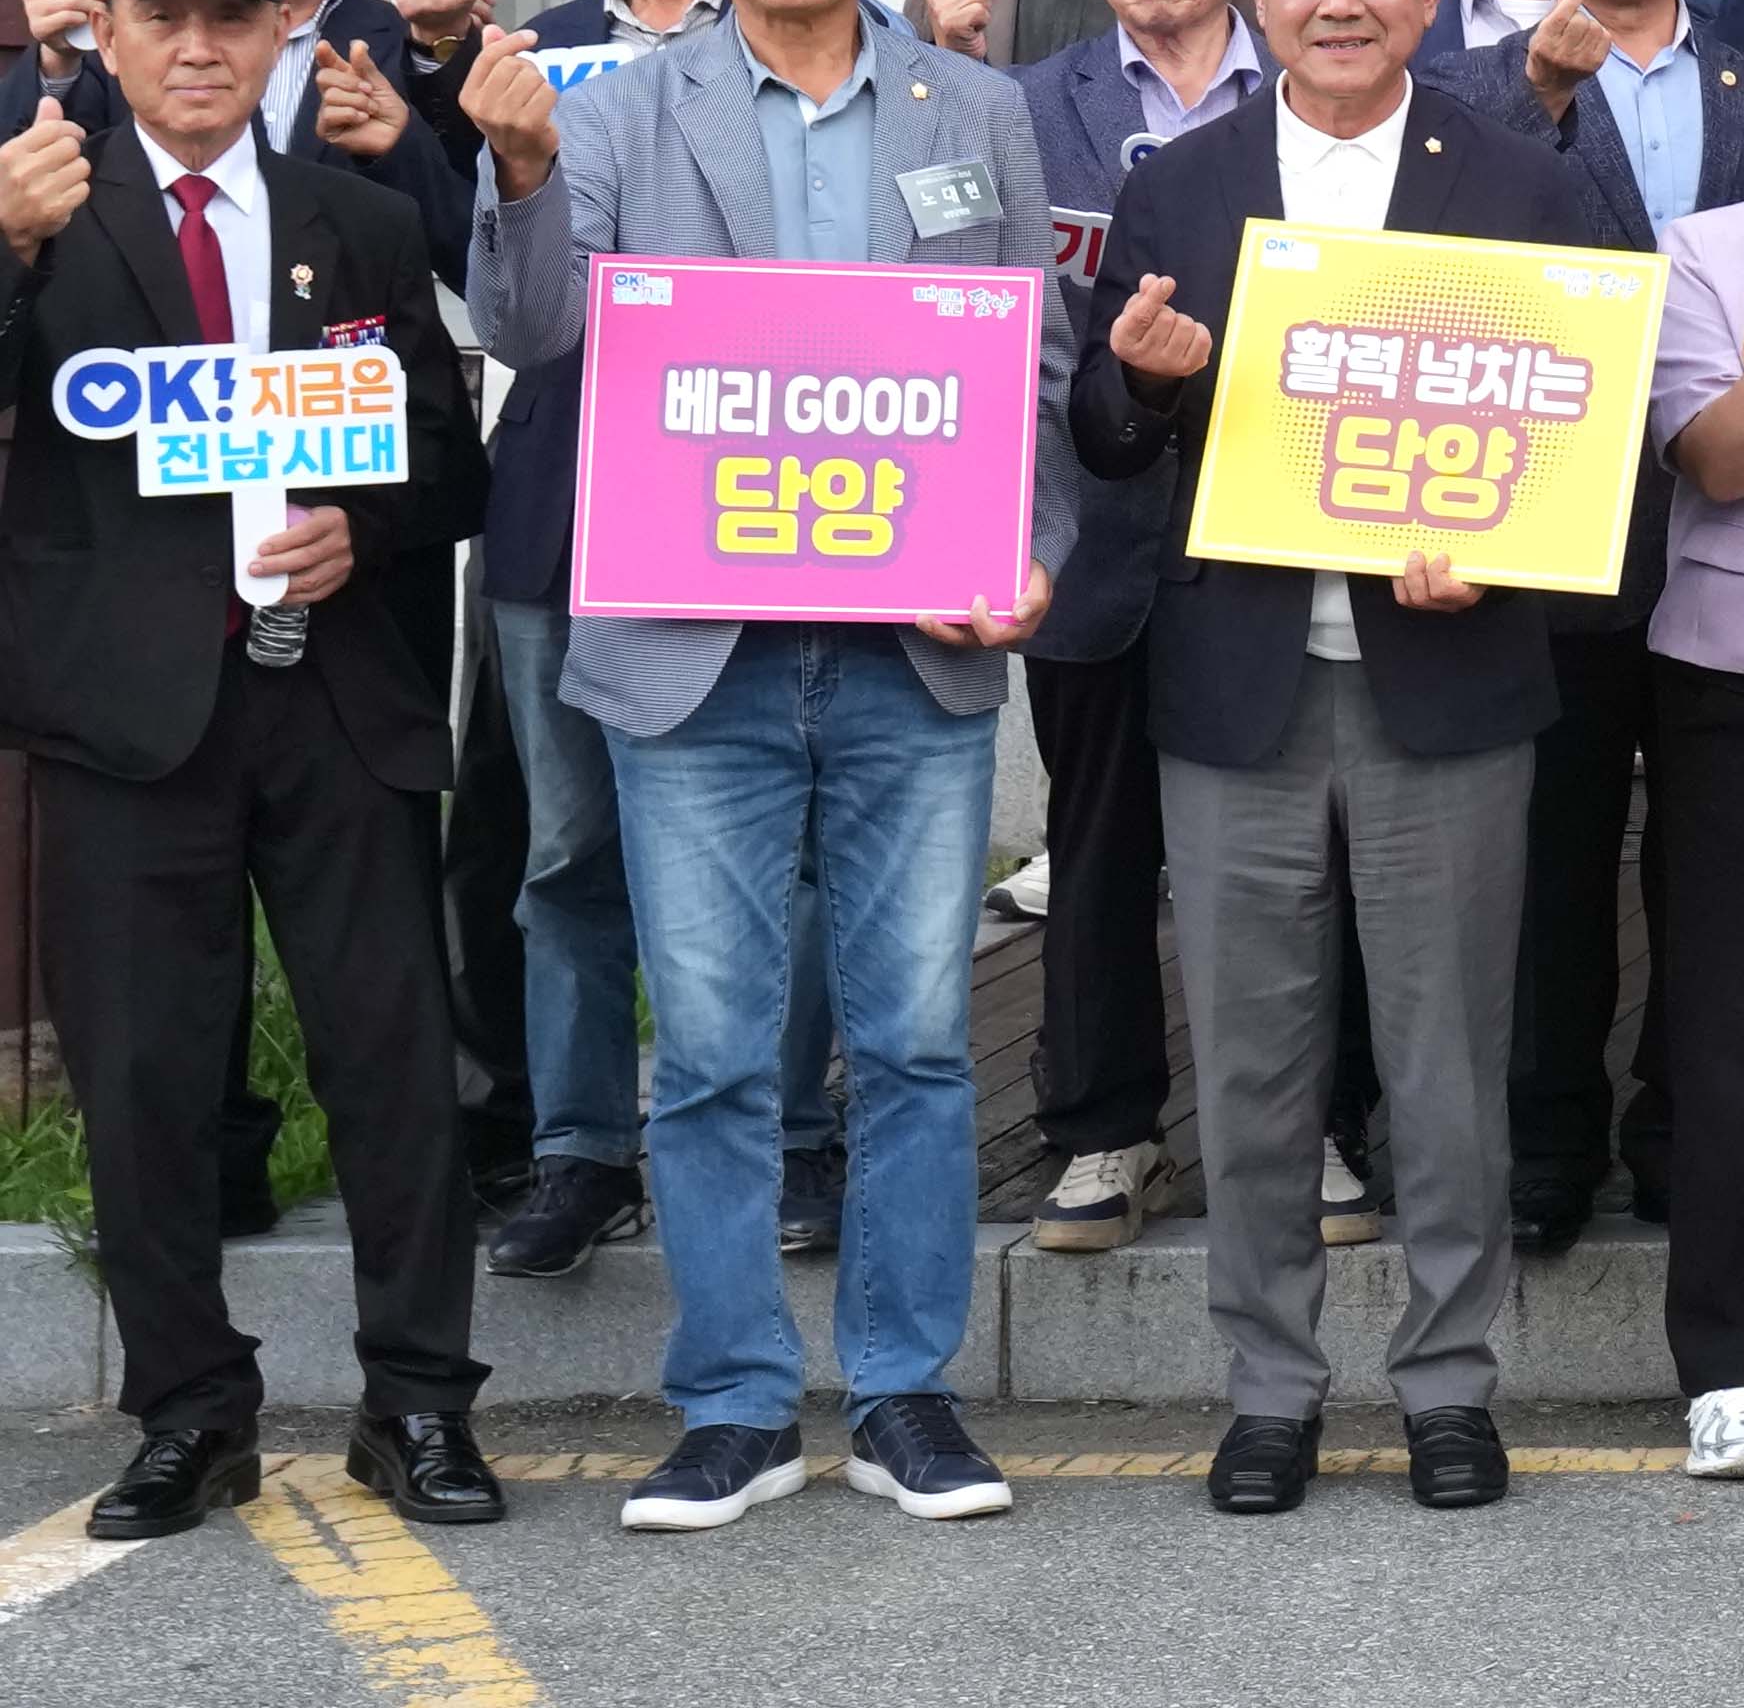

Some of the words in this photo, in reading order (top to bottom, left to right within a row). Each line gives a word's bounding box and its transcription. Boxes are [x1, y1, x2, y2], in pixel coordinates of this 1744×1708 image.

[66, 356, 237, 429] OK!
[250, 357, 394, 418] 지금은
[664, 368, 772, 436] 베리
[784, 375, 959, 438] GOOD!
[1286, 327, 1405, 400] 활력
[1414, 340, 1587, 417] 넘치는
[156, 423, 396, 485] 전남시대
[1330, 415, 1518, 520] 담양
[714, 455, 906, 557] 담양
